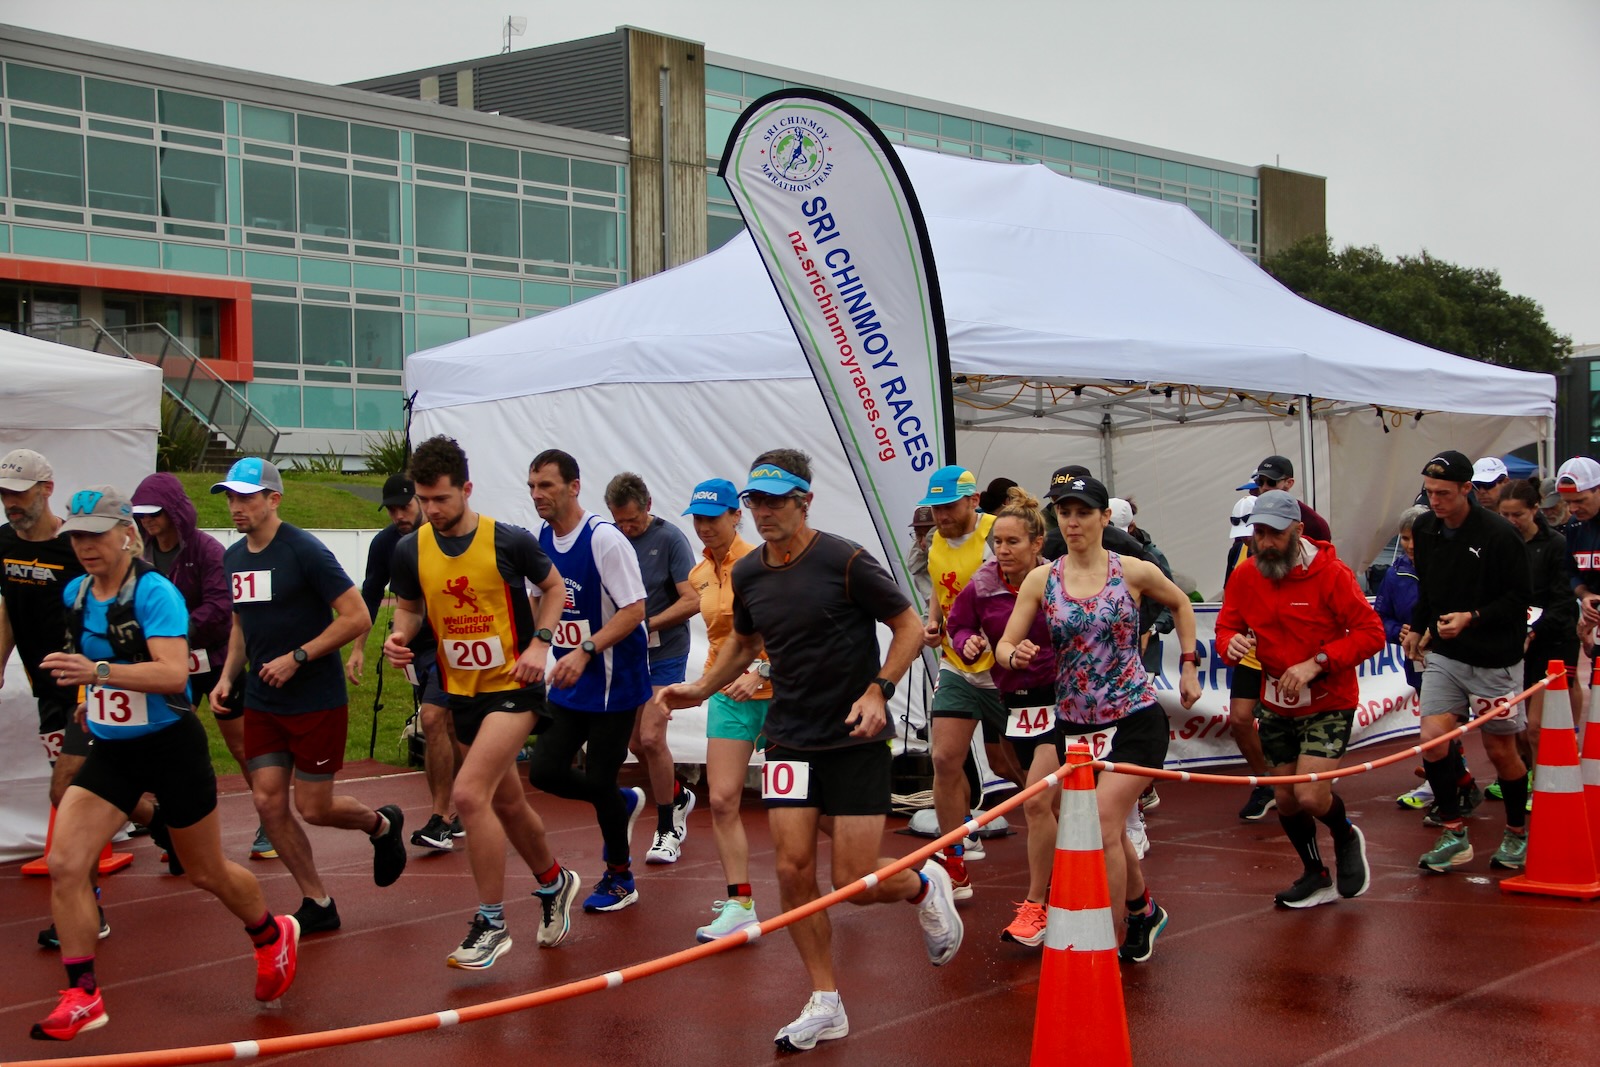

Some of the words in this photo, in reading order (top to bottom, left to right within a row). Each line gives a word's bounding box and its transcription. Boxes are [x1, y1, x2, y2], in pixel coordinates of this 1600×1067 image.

[763, 124, 779, 142] SRI
[779, 116, 830, 140] CHINMOY
[761, 163, 812, 193] MARATHON
[813, 162, 834, 187] TEAM
[788, 230, 897, 462] nz.srichinmoyraces.org
[801, 196, 841, 245] SRI
[825, 248, 898, 370] CHINMOY
[880, 375, 934, 472] RACES
[692, 491, 718, 502] HOKA
[4, 563, 58, 582] HATEA
[232, 572, 256, 600] 31
[443, 614, 494, 626] Wellington
[447, 623, 490, 635] Scottish
[555, 622, 582, 646] 30
[452, 640, 493, 667] 20
[94, 689, 132, 723] 13
[1016, 707, 1050, 734] 44
[761, 762, 795, 795] 10
